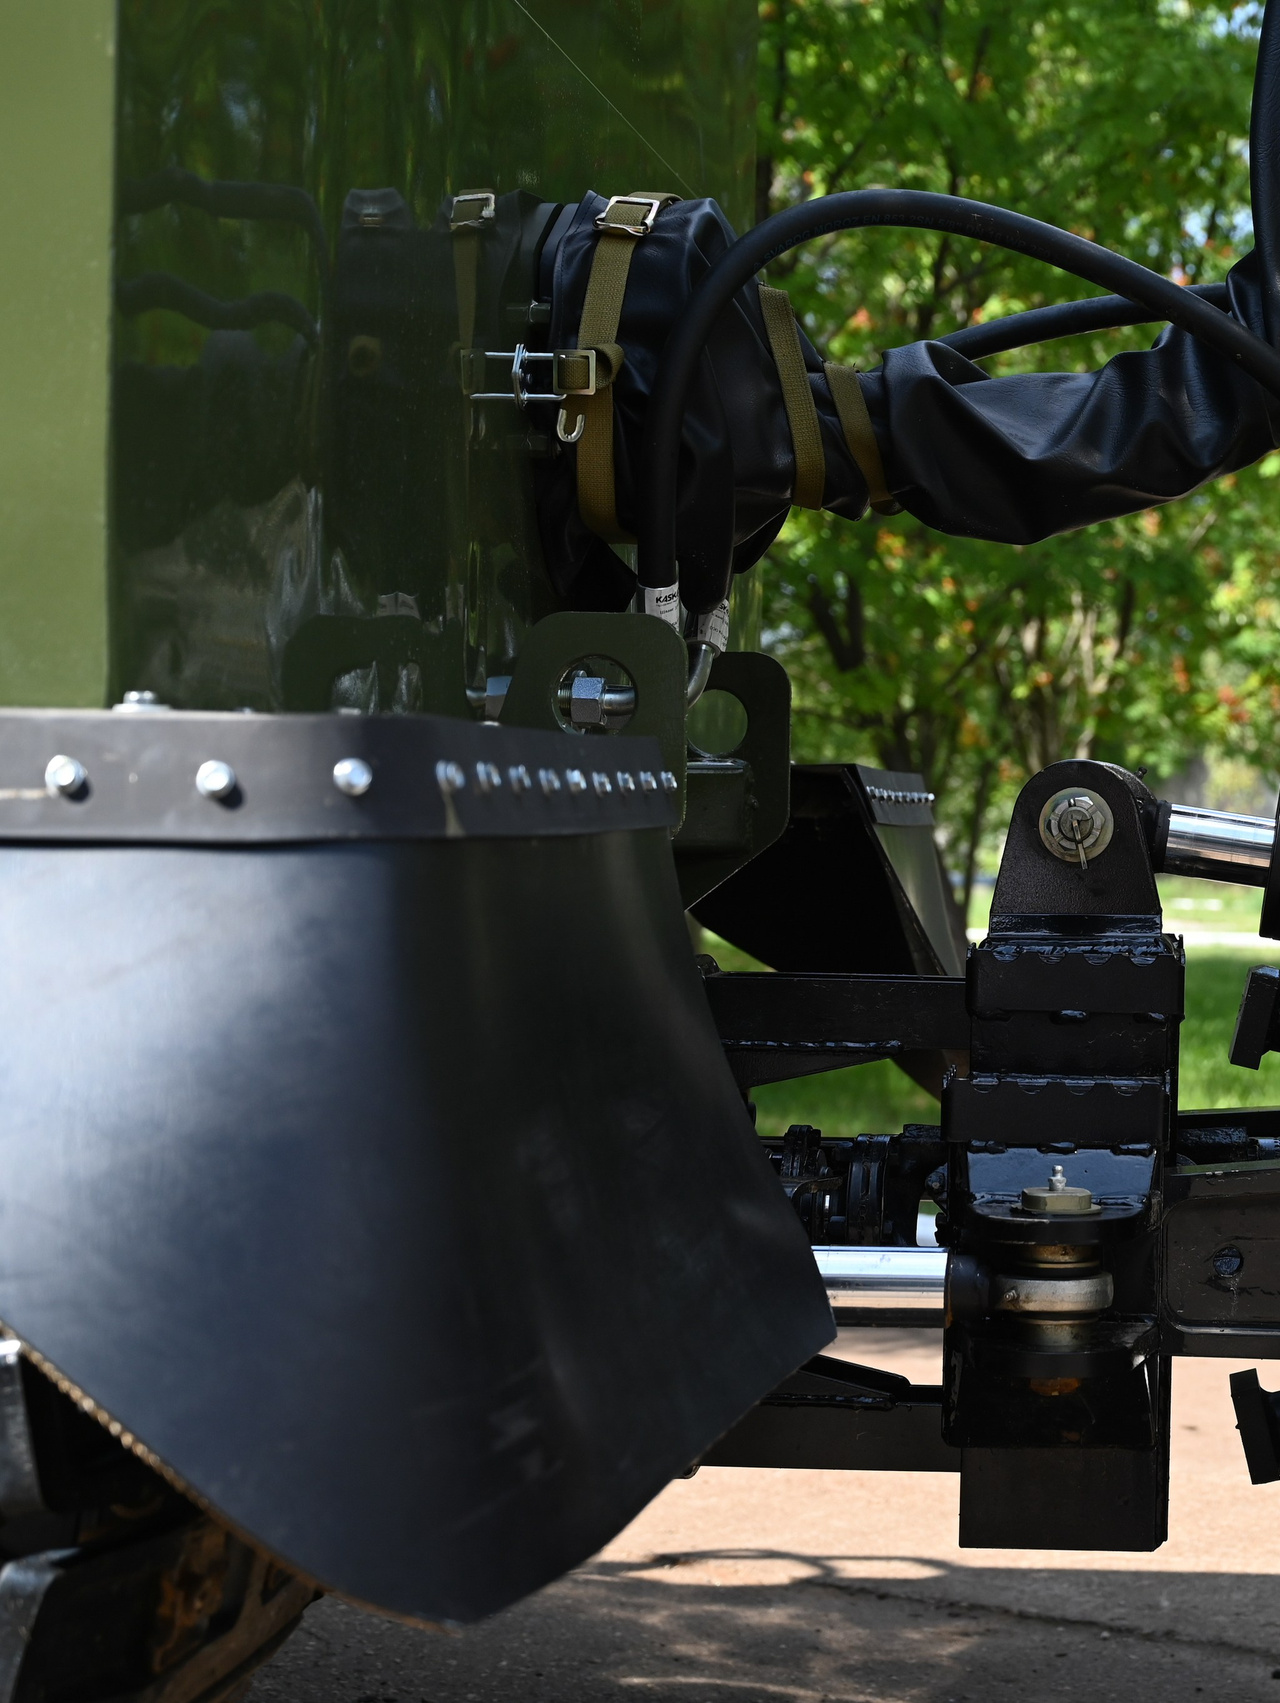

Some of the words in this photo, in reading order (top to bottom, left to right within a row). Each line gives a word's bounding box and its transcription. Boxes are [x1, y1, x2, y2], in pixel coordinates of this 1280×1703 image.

[763, 230, 811, 263] SVAROG
[814, 215, 860, 235] MOROZ
[863, 214, 881, 224] EN
[883, 214, 905, 223] 853
